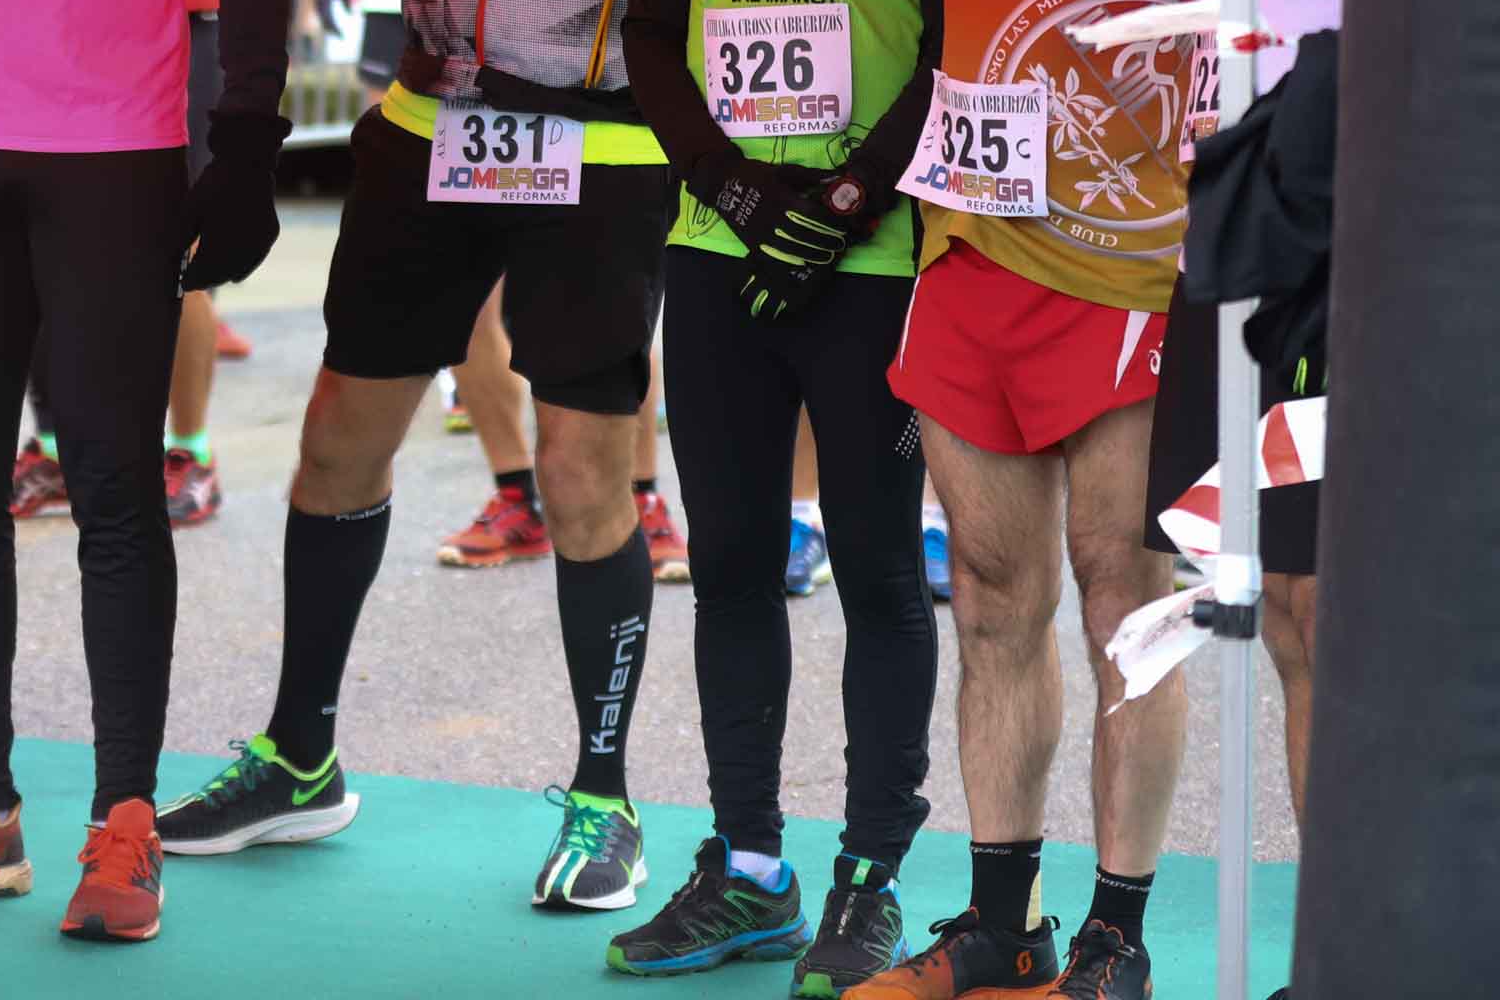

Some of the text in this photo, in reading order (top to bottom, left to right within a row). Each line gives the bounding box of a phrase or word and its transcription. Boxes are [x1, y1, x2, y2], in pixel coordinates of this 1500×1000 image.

[738, 16, 772, 37] CROSS
[774, 13, 844, 35] CABRERIZOS
[1005, 15, 1031, 46] LAS
[719, 38, 815, 95] 326
[715, 94, 840, 123] JOMISAGA
[972, 94, 1041, 113] CABRERIZOS
[461, 114, 546, 165] 331
[763, 120, 839, 134] REFORMAS
[940, 109, 1010, 174] 325
[438, 166, 571, 191] JOMISAGA
[914, 162, 1035, 203] JOMISAGA
[500, 191, 567, 201] REFORMAS
[965, 199, 1035, 215] REFORMAS
[1069, 223, 1119, 248] CLUB
[589, 615, 646, 754] Kalenji
